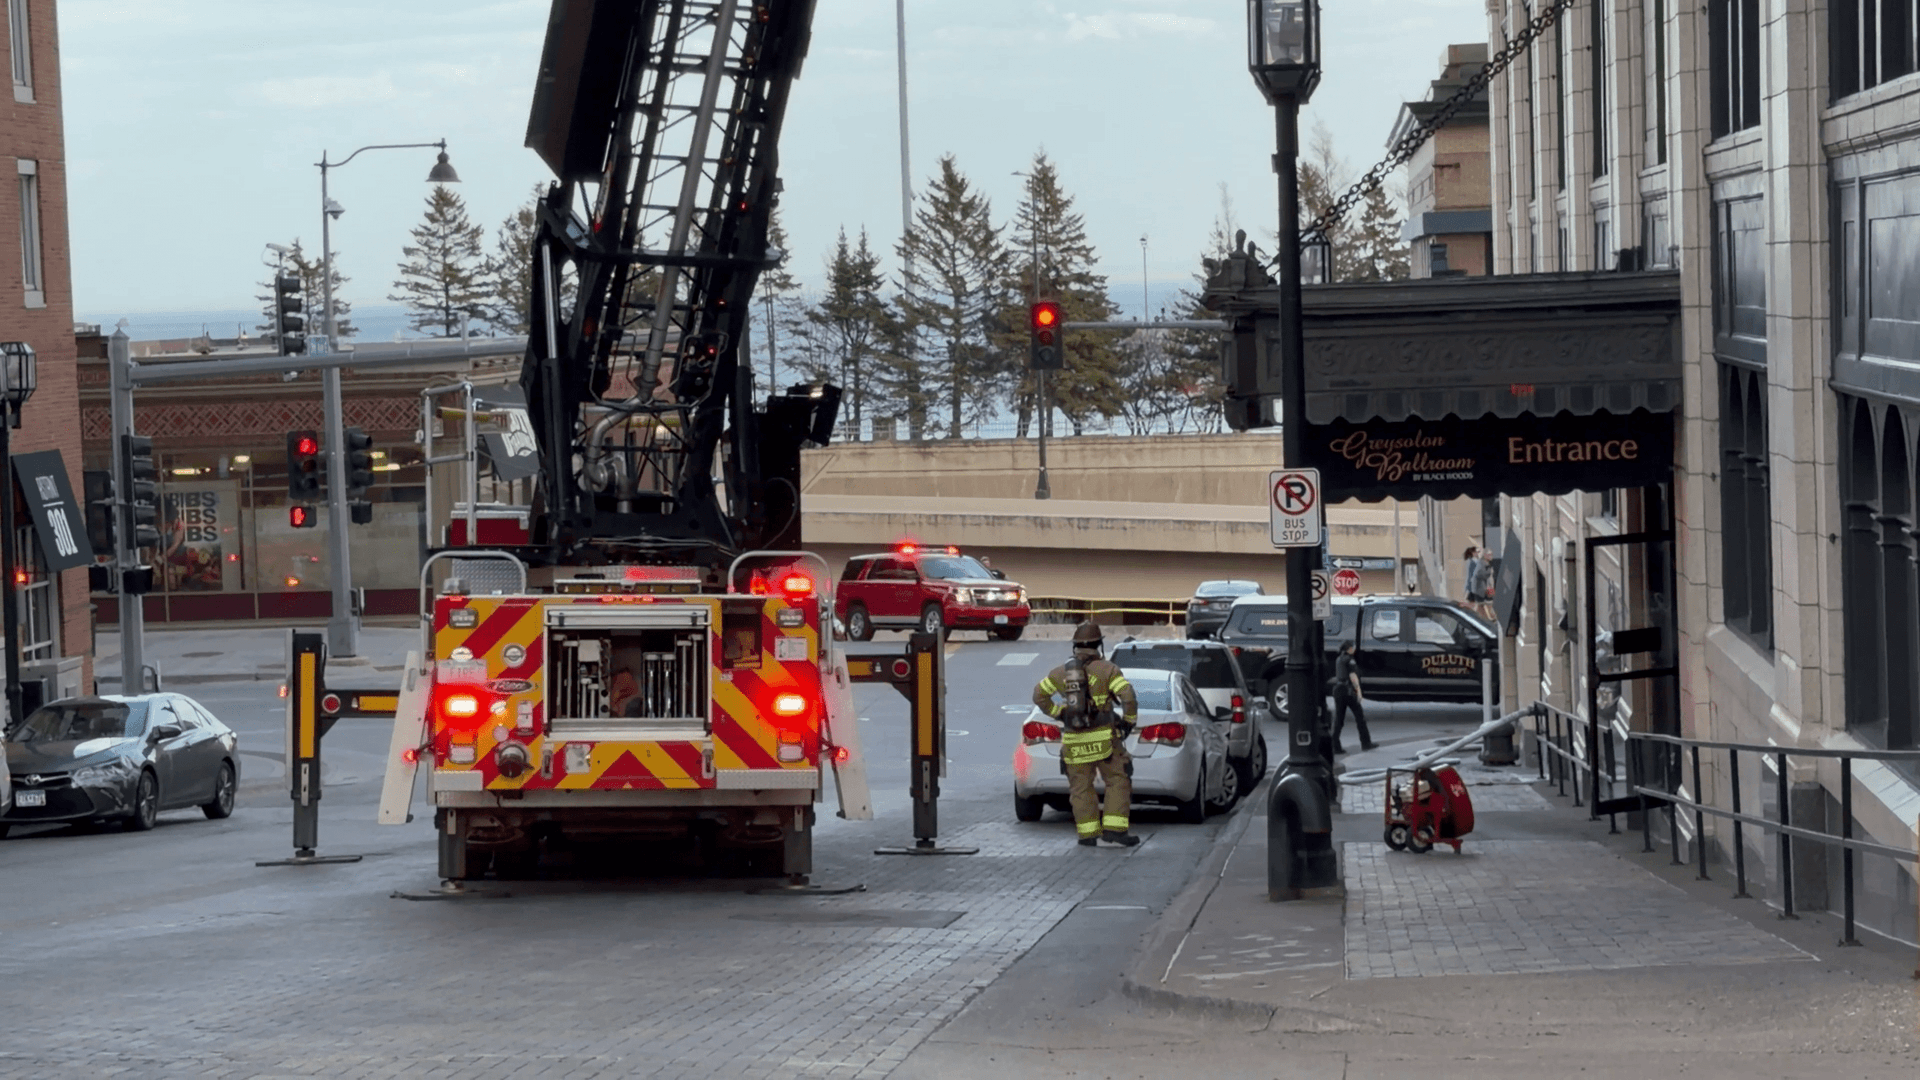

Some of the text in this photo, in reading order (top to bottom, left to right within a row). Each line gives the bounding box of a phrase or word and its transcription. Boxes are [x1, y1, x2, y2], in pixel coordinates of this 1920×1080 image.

[1329, 429, 1445, 469] Greysolon
[1508, 436, 1638, 463] Entrance
[1365, 452, 1475, 481] Ballroom
[1284, 519, 1306, 529] BUS
[47, 508, 78, 557] 301
[1282, 531, 1309, 541] STOP
[1334, 577, 1359, 589] STOP
[1421, 653, 1475, 669] DULUTH
[1428, 667, 1446, 675] FIRE
